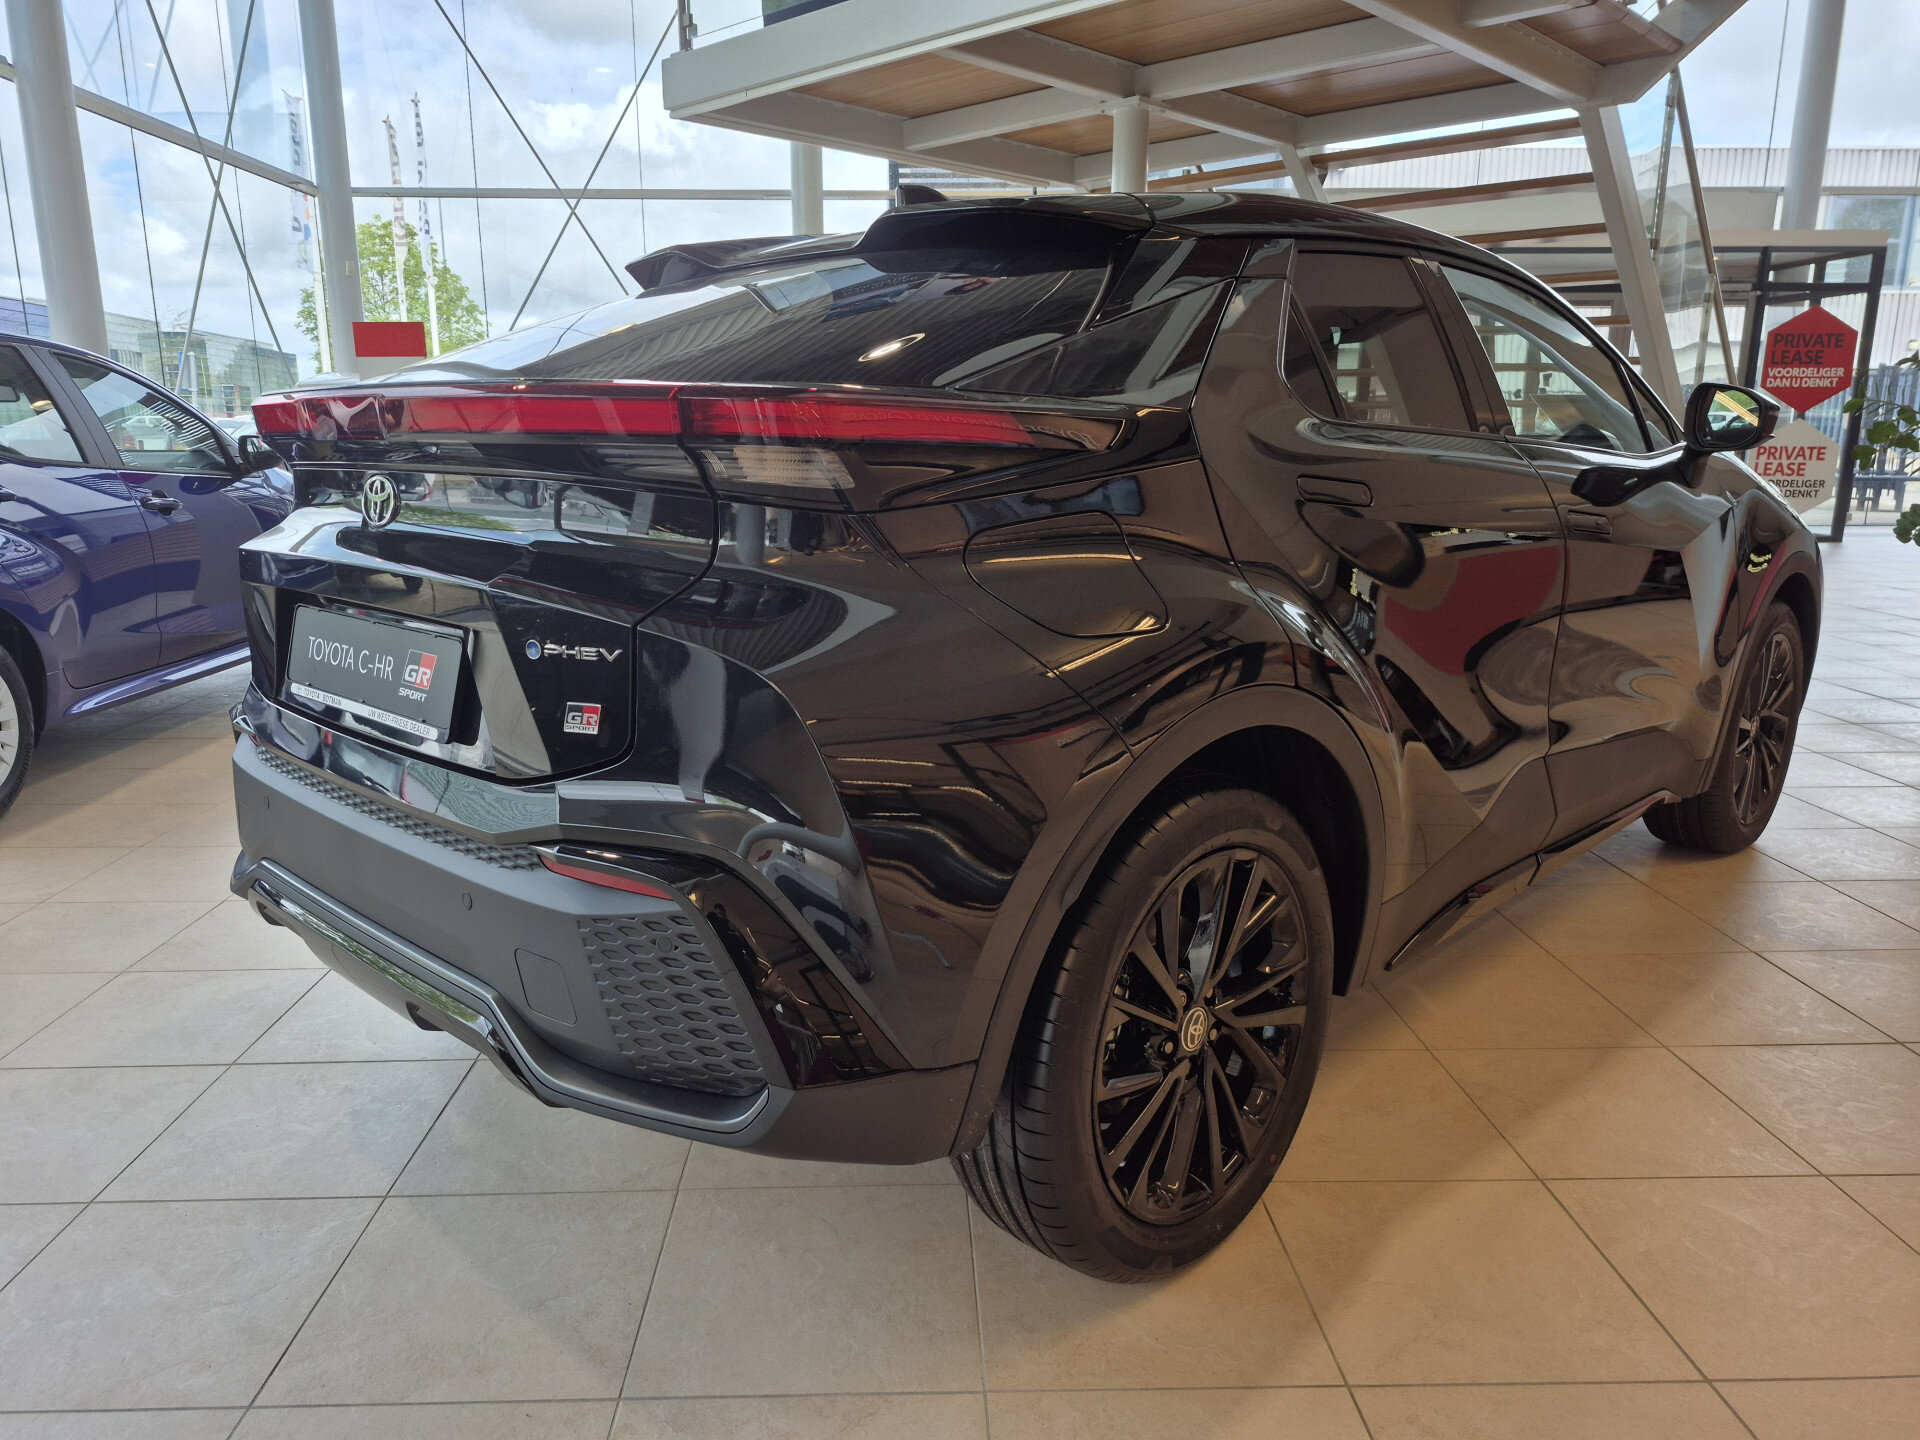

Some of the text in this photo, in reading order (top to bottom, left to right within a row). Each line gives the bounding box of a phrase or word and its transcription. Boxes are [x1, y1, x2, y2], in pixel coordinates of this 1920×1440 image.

[1773, 333, 1846, 349] PRIVATE
[1770, 350, 1825, 365] LEASE
[1768, 367, 1845, 377] VOORDELIGER
[1766, 378, 1839, 388] DAN U DENKT
[1755, 446, 1827, 461] PRIVATE
[1754, 462, 1806, 477] LEASE
[1784, 489, 1820, 498] DENKT
[308, 636, 394, 681] TOYOTA C-HR
[543, 641, 623, 663] PHEV
[404, 664, 432, 687] GR
[303, 688, 342, 706] TOYOTA BOTMAN
[398, 687, 428, 703] SPORT
[367, 708, 431, 737] UW WEST-FRIESE DEALER
[567, 711, 599, 727] GR
[565, 724, 597, 733] SPORT
